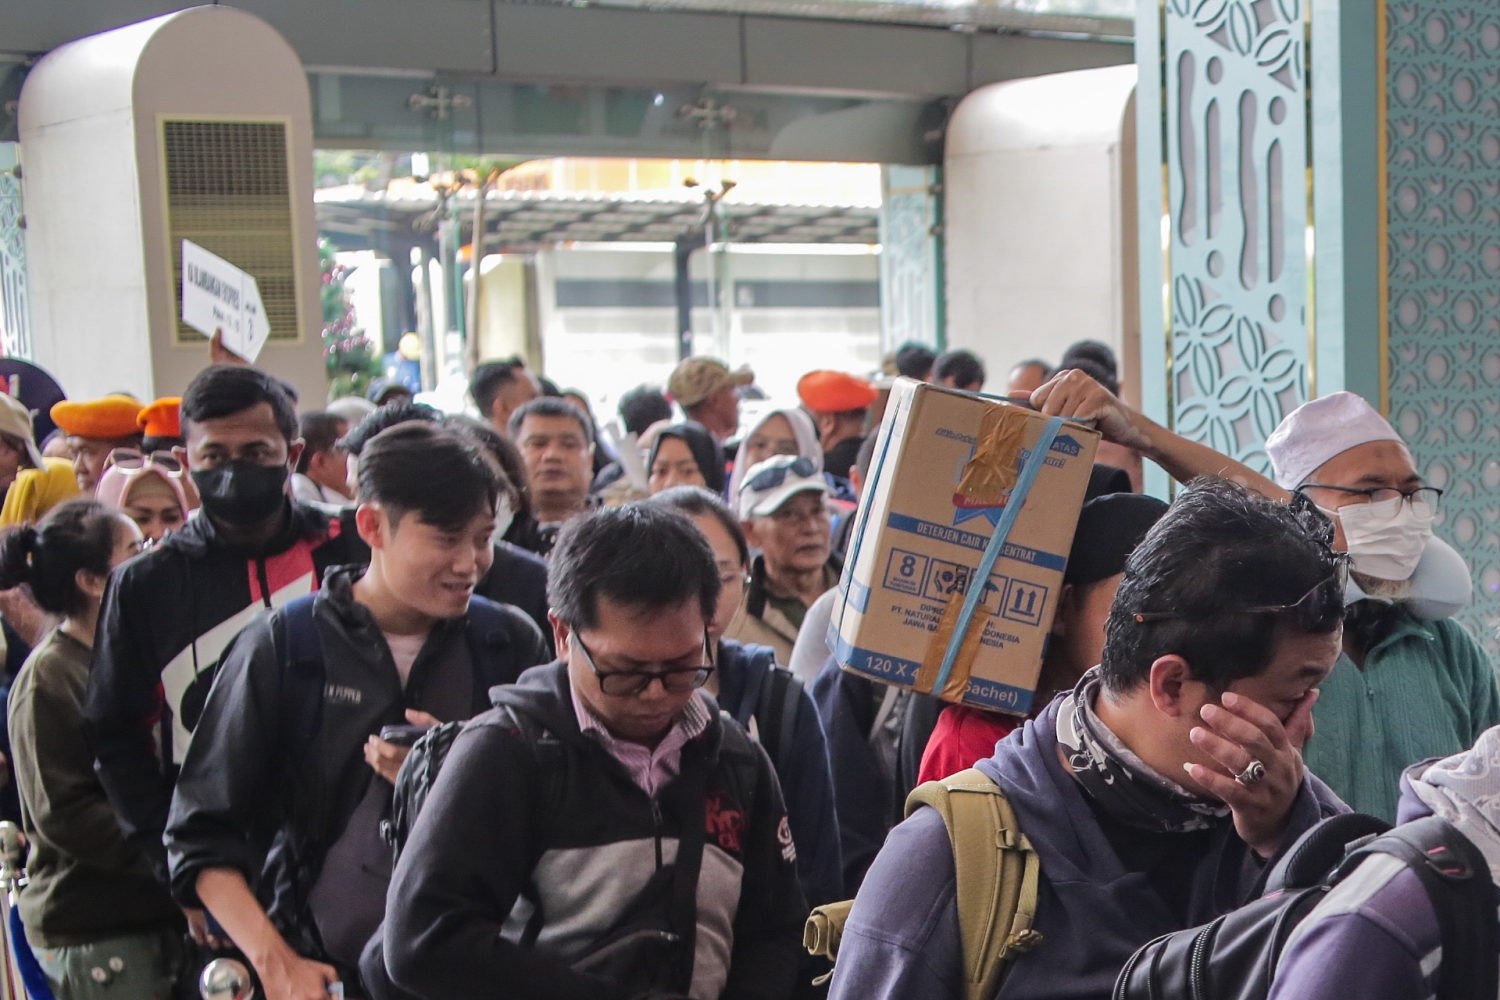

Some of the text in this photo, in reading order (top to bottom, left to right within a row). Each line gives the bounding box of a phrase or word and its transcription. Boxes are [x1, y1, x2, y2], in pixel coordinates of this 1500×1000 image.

[1052, 441, 1077, 455] ATAS
[916, 522, 1037, 562] DETERJEN CAIR KENTRAT
[900, 555, 916, 577] 8
[902, 618, 926, 630] JAWA
[866, 655, 892, 673] 120
[895, 664, 906, 677] X
